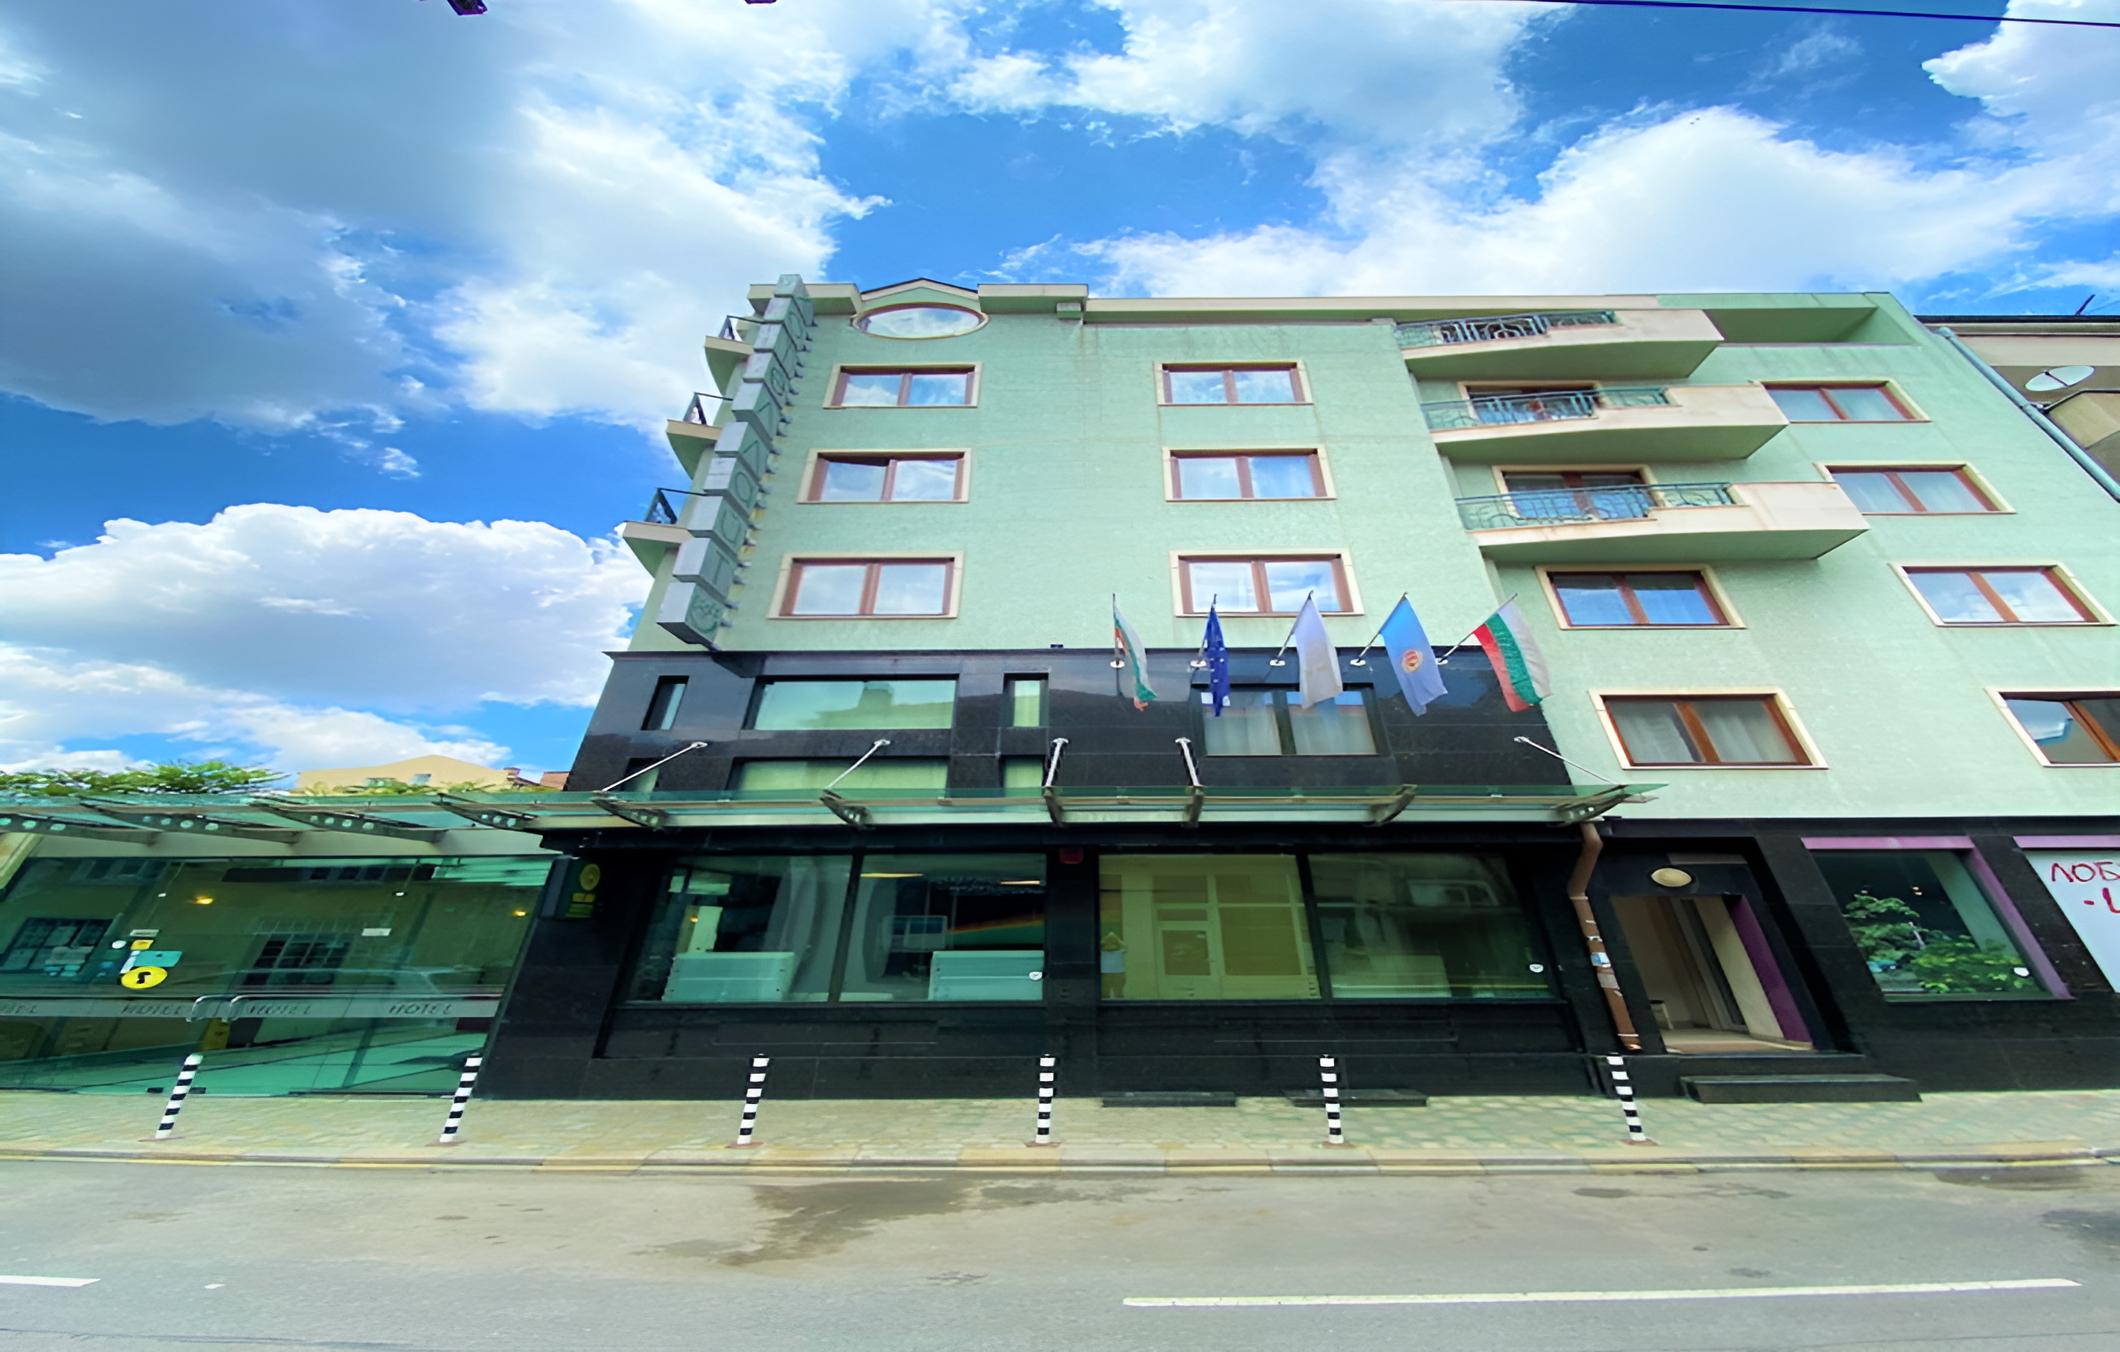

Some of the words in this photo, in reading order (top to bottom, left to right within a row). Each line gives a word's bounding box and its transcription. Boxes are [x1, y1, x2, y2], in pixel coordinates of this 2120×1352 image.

[121, 1004, 183, 1015] HOTEL
[249, 1004, 312, 1015] HOTEL
[388, 1003, 453, 1015] HOTEL
